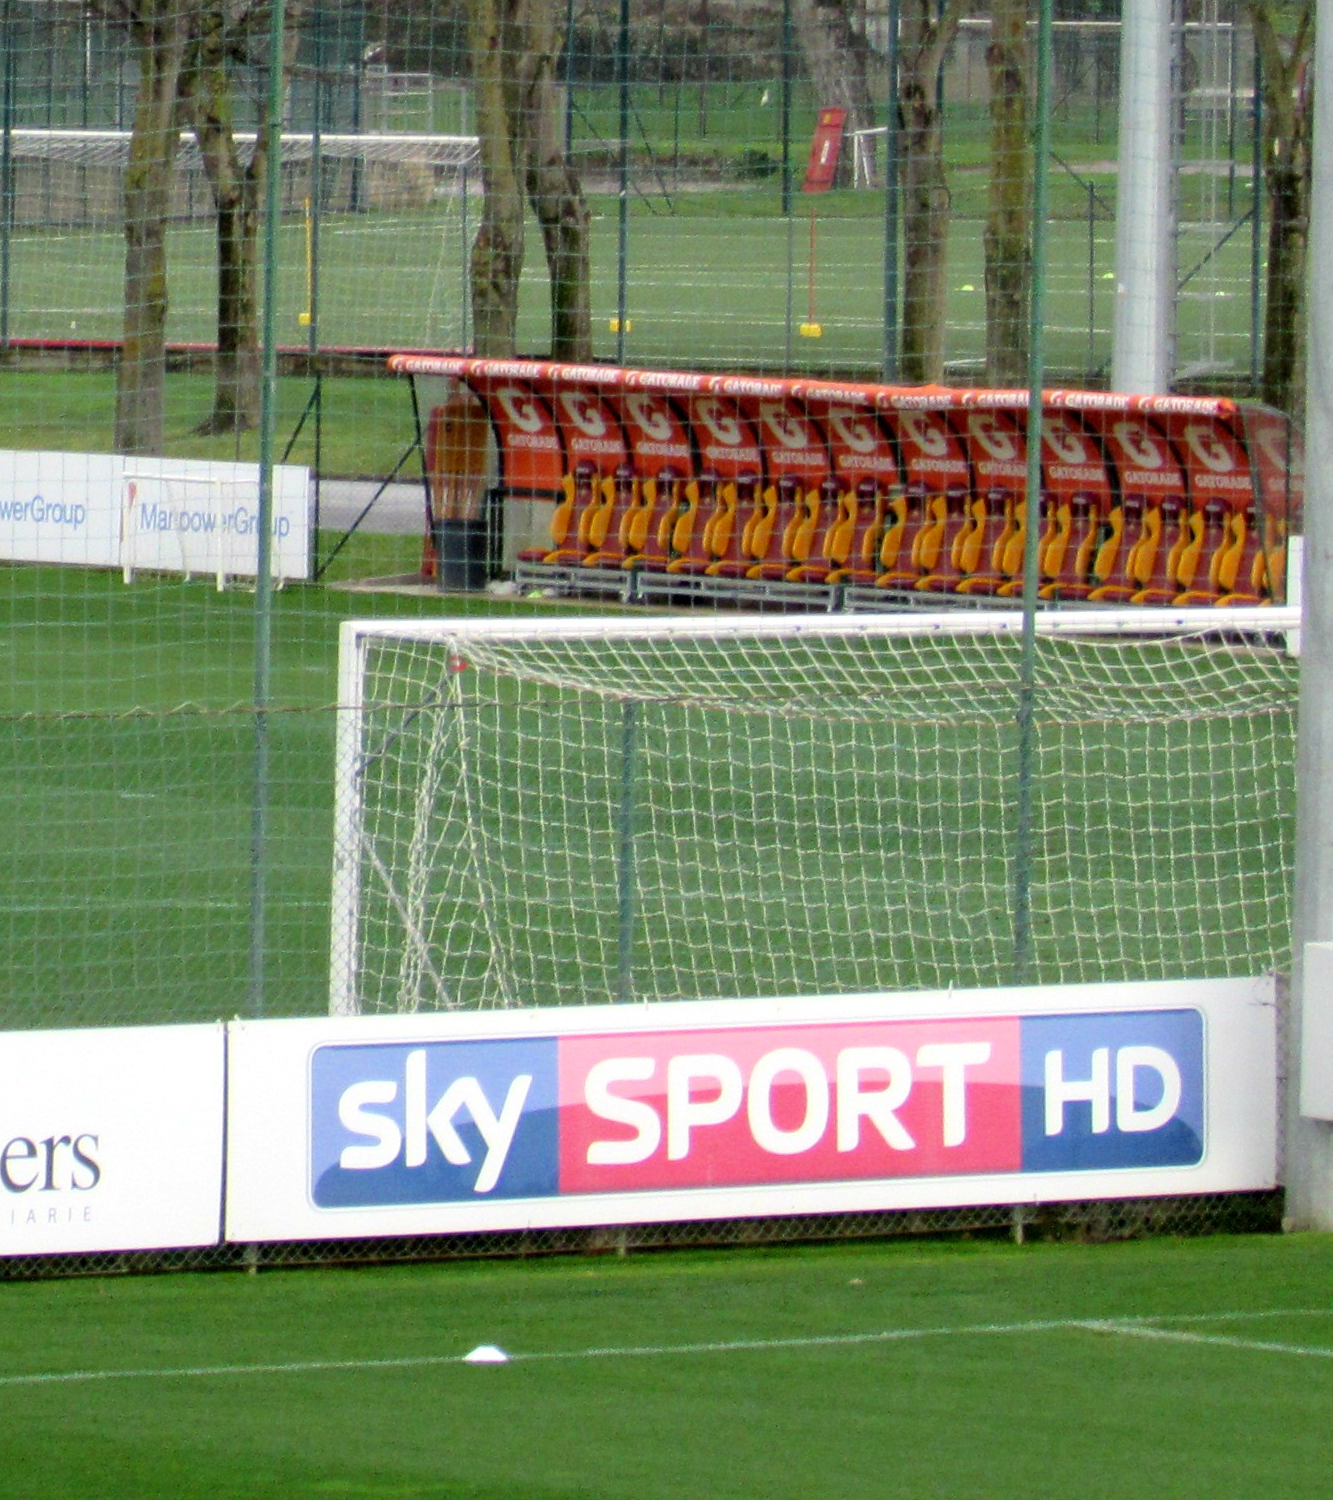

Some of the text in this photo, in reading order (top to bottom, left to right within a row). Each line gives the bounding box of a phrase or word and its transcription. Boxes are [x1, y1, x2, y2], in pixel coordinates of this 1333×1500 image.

[338, 1042, 1183, 1192] sky SPORT HD
